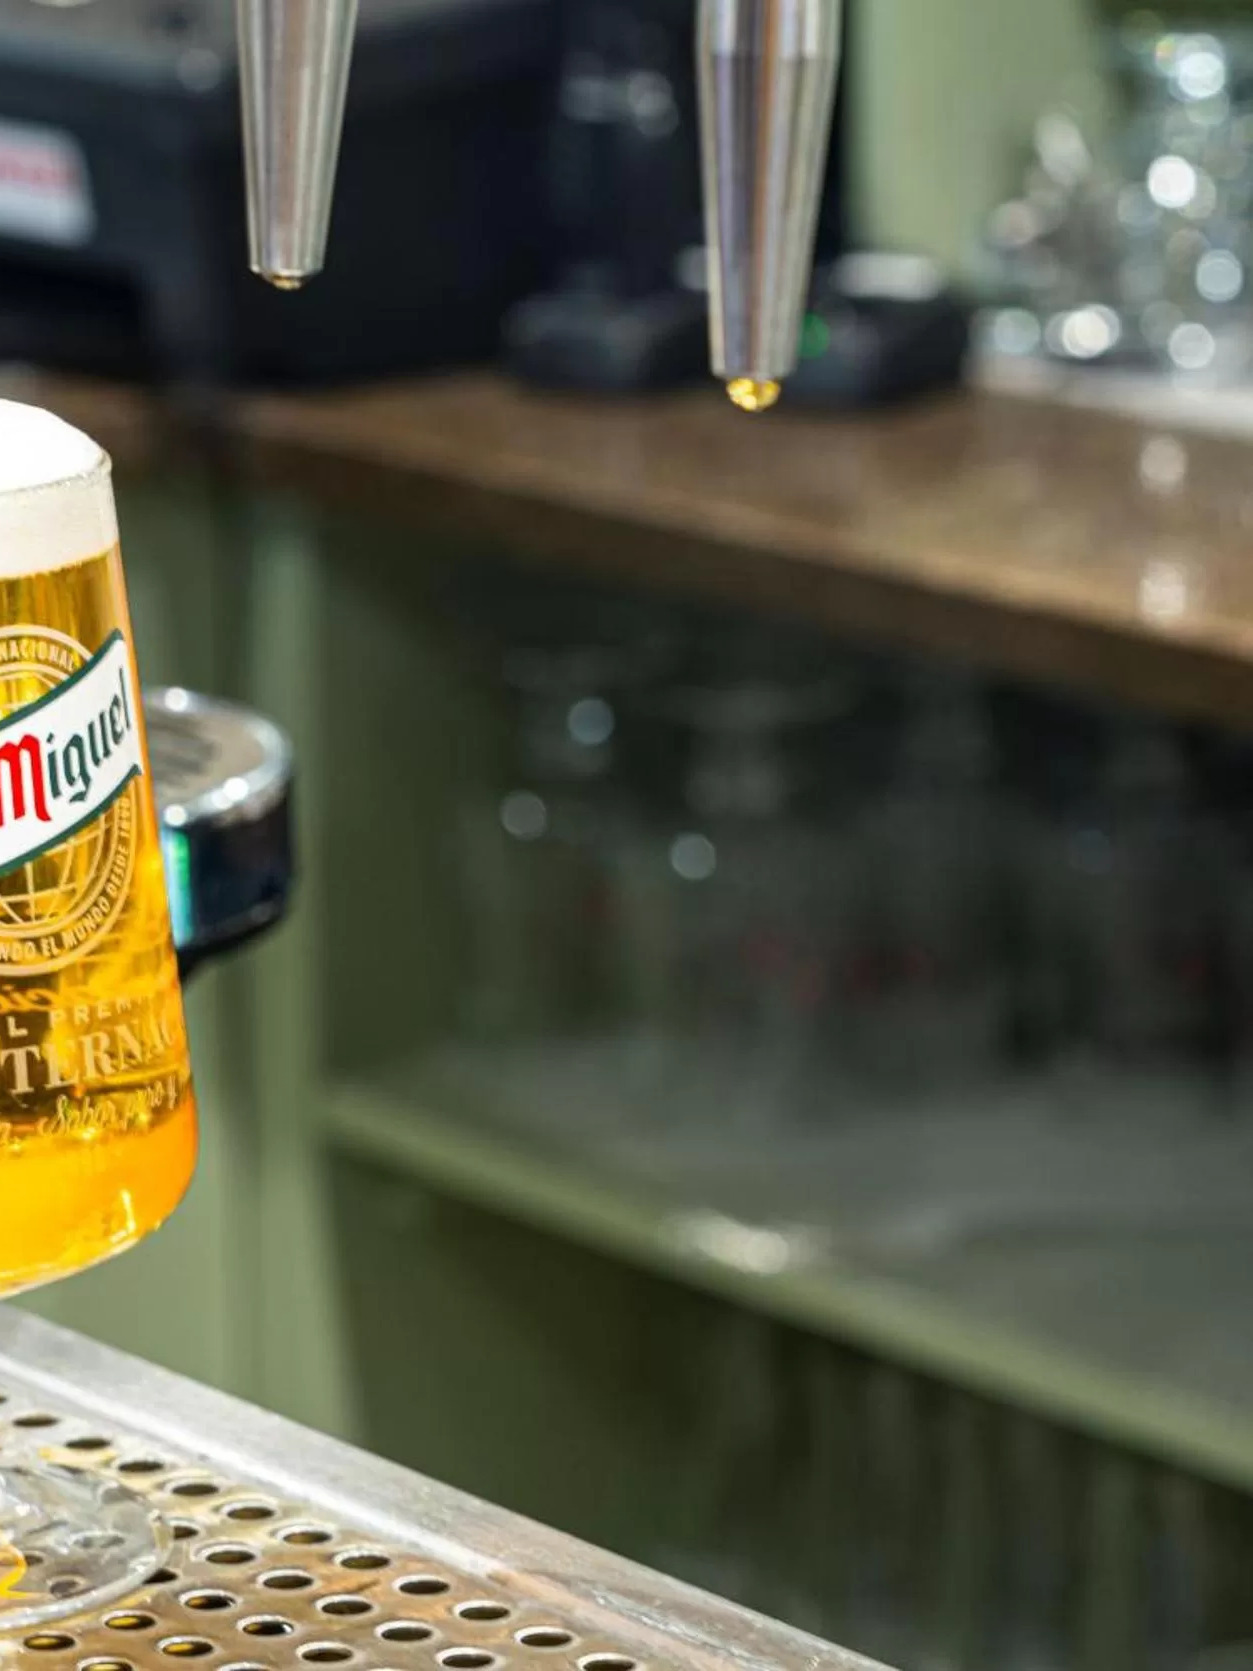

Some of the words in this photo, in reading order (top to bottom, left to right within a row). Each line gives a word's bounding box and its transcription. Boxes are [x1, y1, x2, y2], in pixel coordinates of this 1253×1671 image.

[40, 936, 59, 957] EL
[61, 897, 111, 950] MUNDO
[106, 844, 129, 898] DESDE
